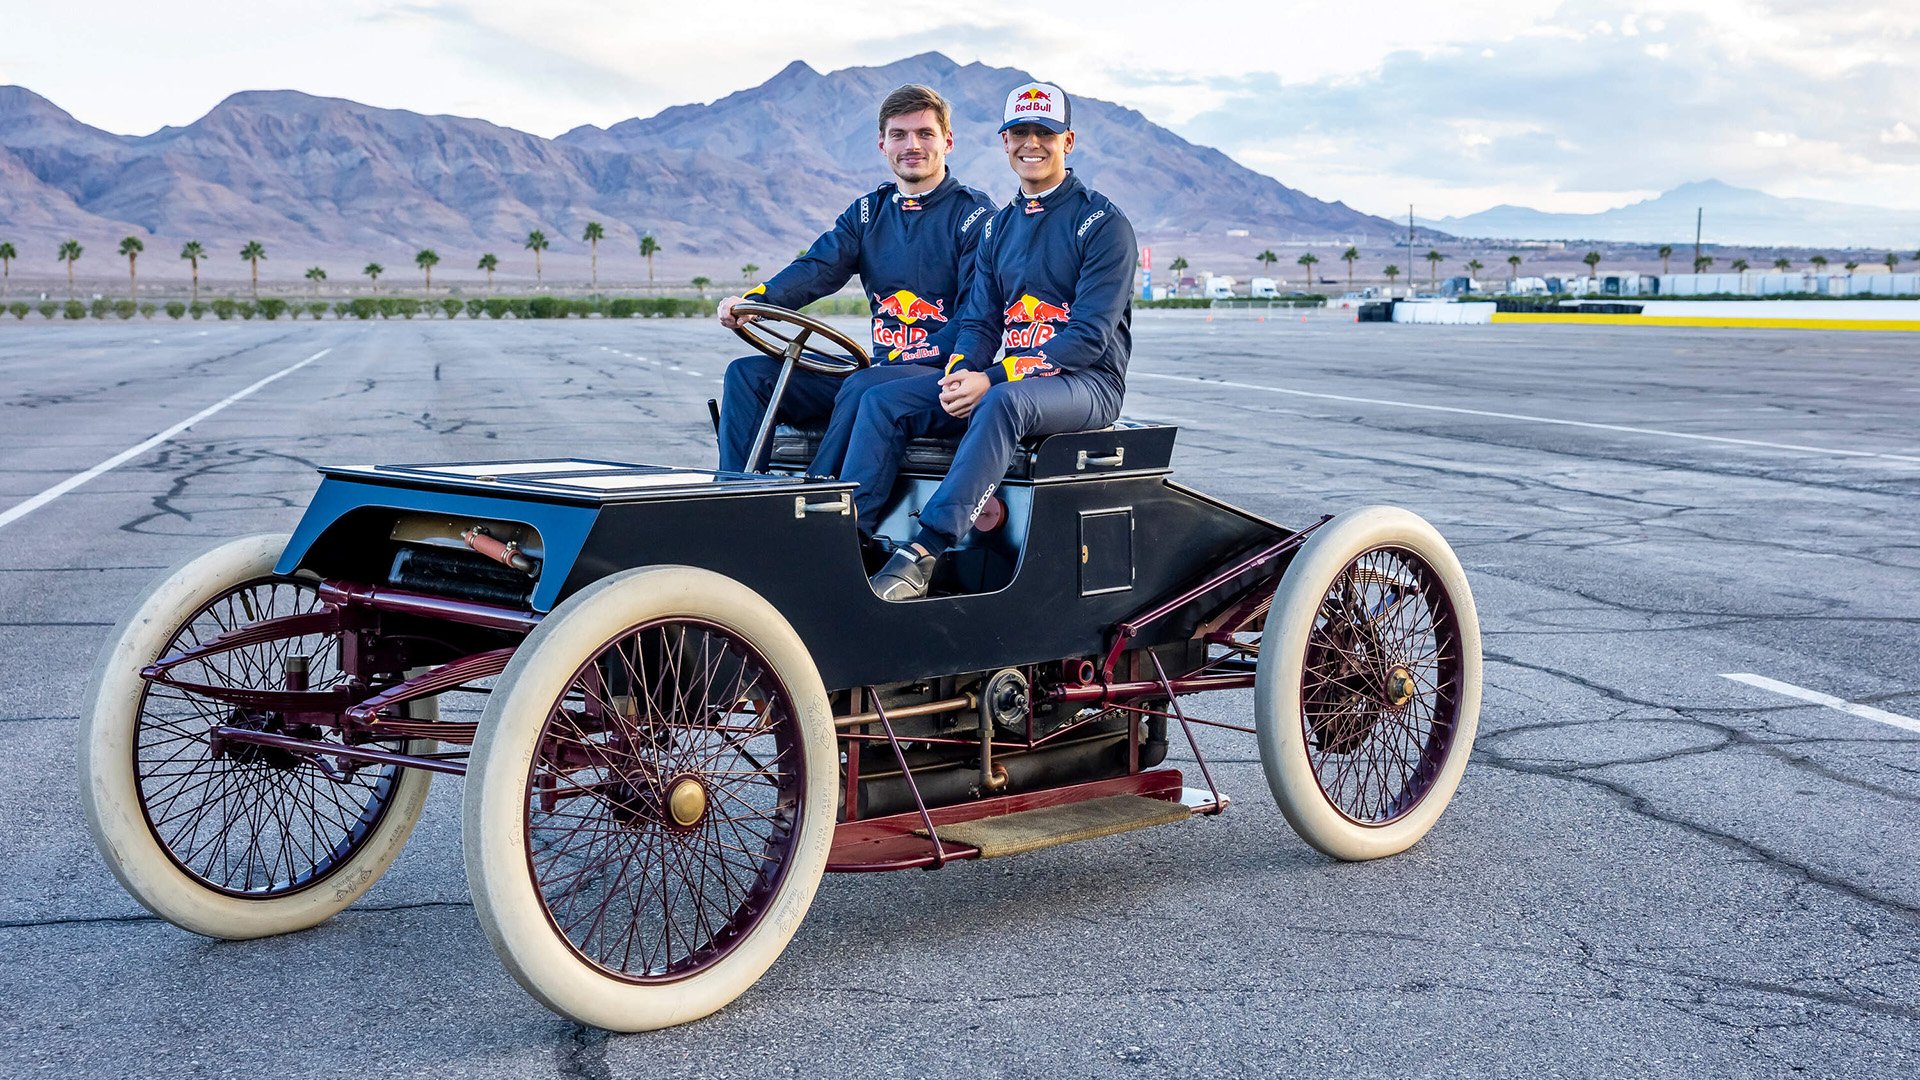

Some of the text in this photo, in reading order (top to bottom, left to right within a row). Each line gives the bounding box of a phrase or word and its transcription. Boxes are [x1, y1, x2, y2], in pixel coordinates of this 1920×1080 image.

[1015, 102, 1051, 113] Red Bull
[961, 206, 987, 232] sparco
[1077, 210, 1106, 237] sparco
[902, 346, 939, 361] Red Bull
[969, 483, 996, 523] sparco
